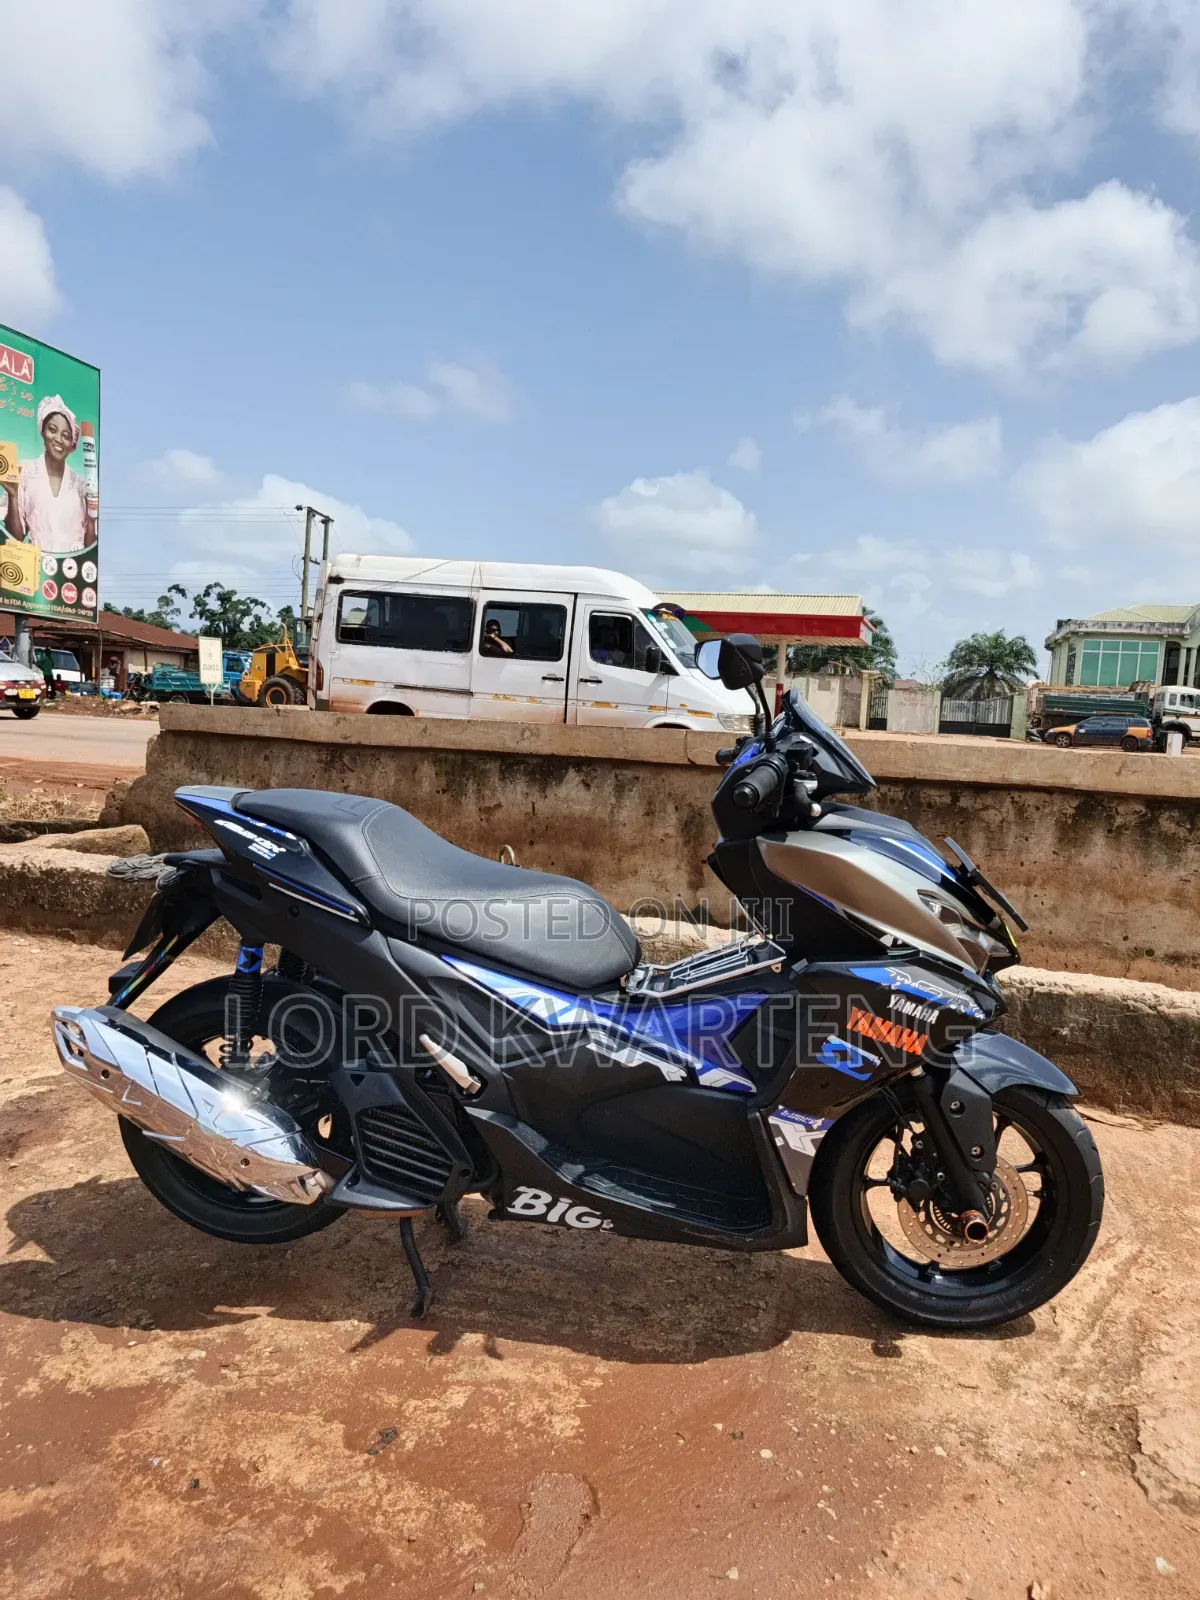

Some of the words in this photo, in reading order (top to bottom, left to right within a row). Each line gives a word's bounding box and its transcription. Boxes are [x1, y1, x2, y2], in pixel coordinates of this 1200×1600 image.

[22, 601, 51, 611] Approved
[887, 994, 940, 1025] YAMAHA
[846, 1006, 929, 1057] YAMAHA
